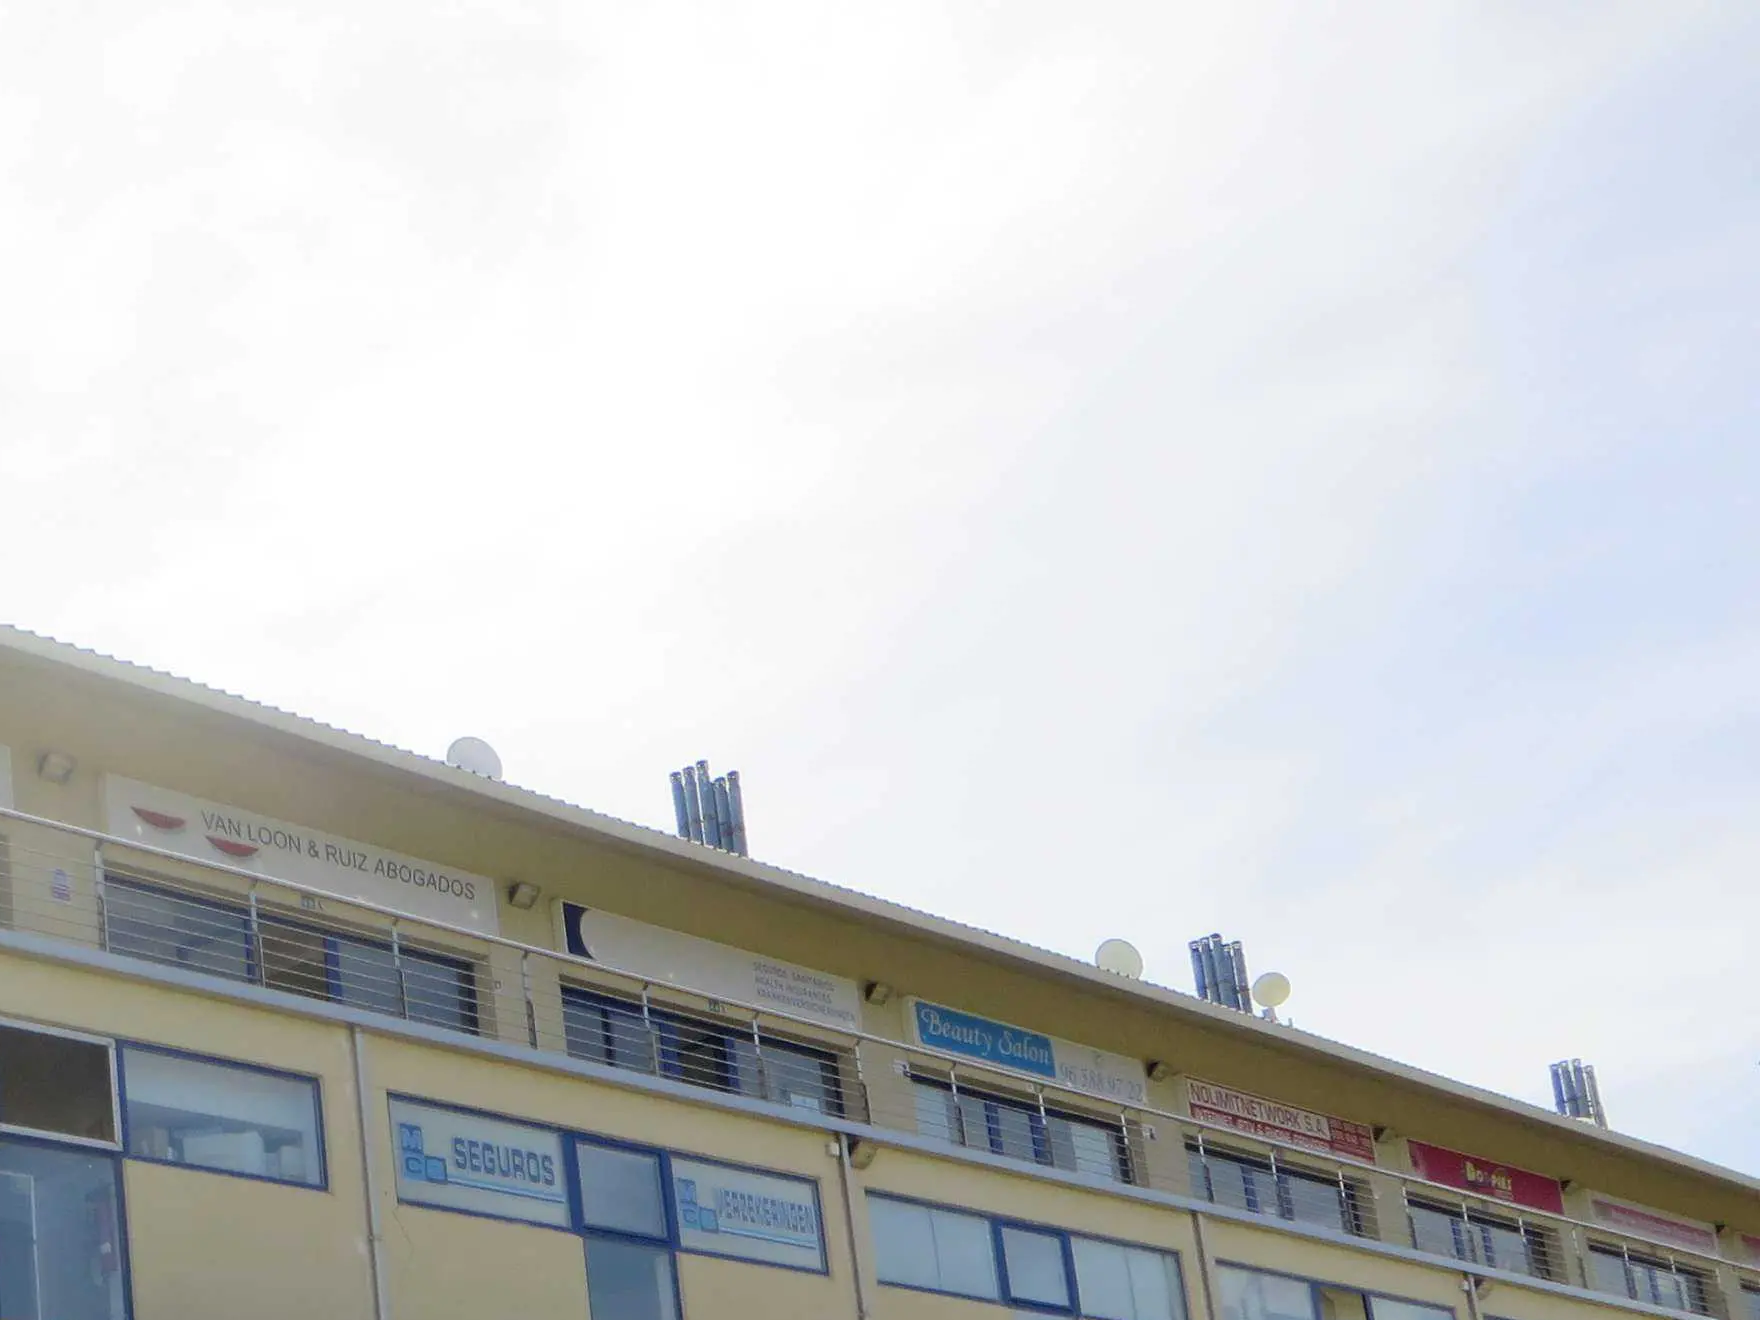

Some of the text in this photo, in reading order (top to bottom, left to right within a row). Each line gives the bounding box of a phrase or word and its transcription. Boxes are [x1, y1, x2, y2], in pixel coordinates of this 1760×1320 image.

[200, 808, 475, 901] VAN LOON & RUIZ ABOGADOS
[921, 1008, 1051, 1065] Beauty Salon
[452, 1136, 556, 1187] SEGUROS
